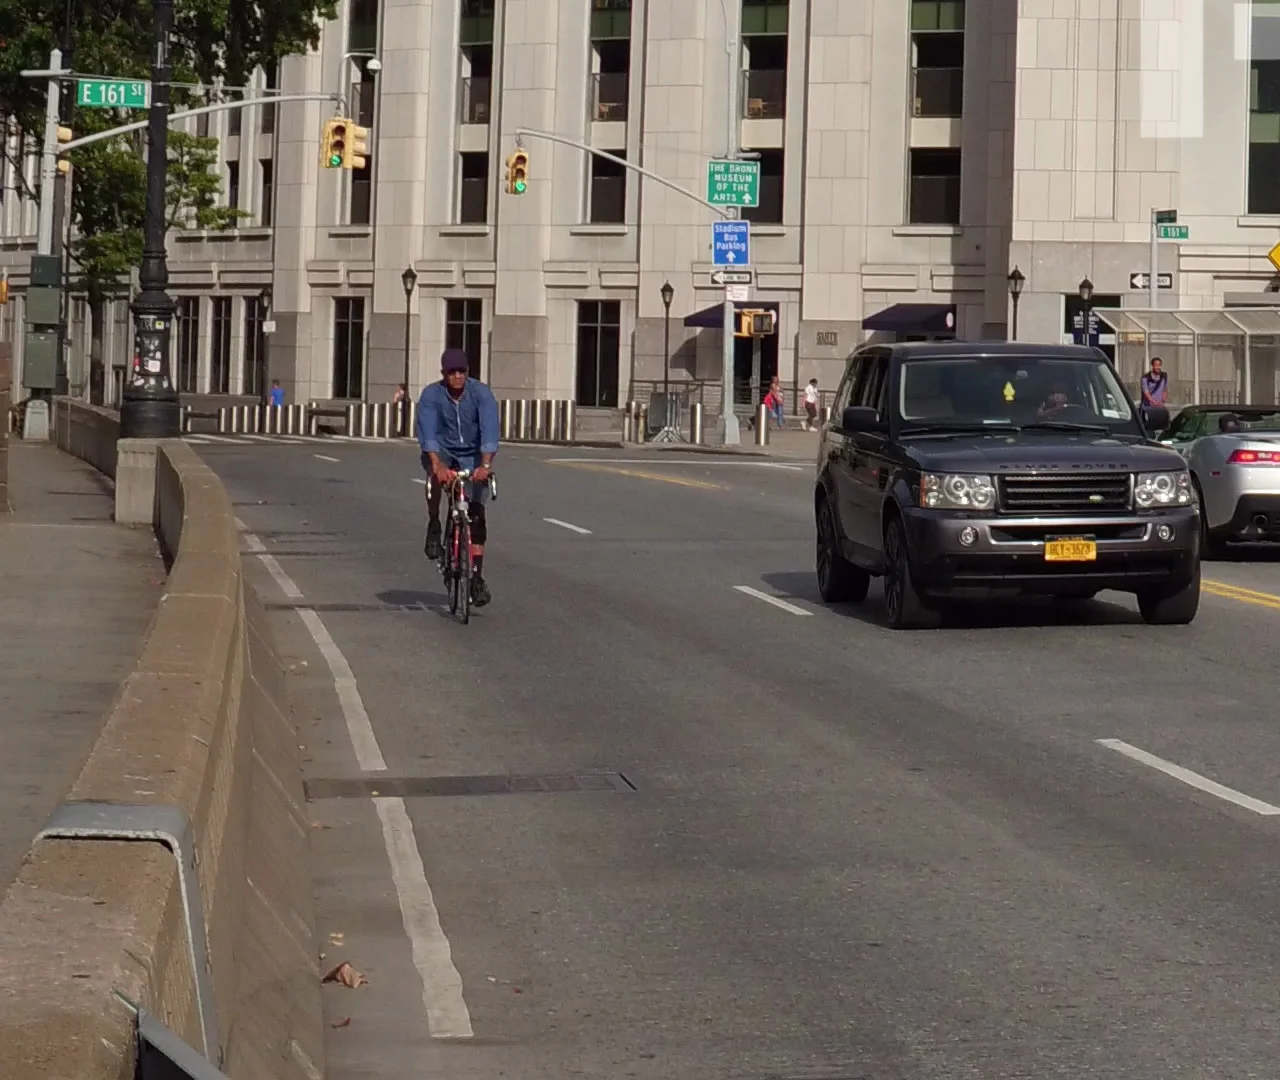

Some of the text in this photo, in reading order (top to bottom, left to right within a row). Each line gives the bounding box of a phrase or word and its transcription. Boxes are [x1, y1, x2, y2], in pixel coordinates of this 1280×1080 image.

[83, 83, 142, 104] E 161 St
[709, 163, 725, 172] THE
[714, 173, 752, 182] MUSEUM
[732, 184, 749, 192] THE
[712, 193, 737, 202] ARTS
[715, 224, 746, 233] Stadium
[1161, 227, 1165, 237] E
[724, 233, 738, 241] Bus
[716, 241, 746, 252] Parking
[816, 332, 838, 341] SUITE
